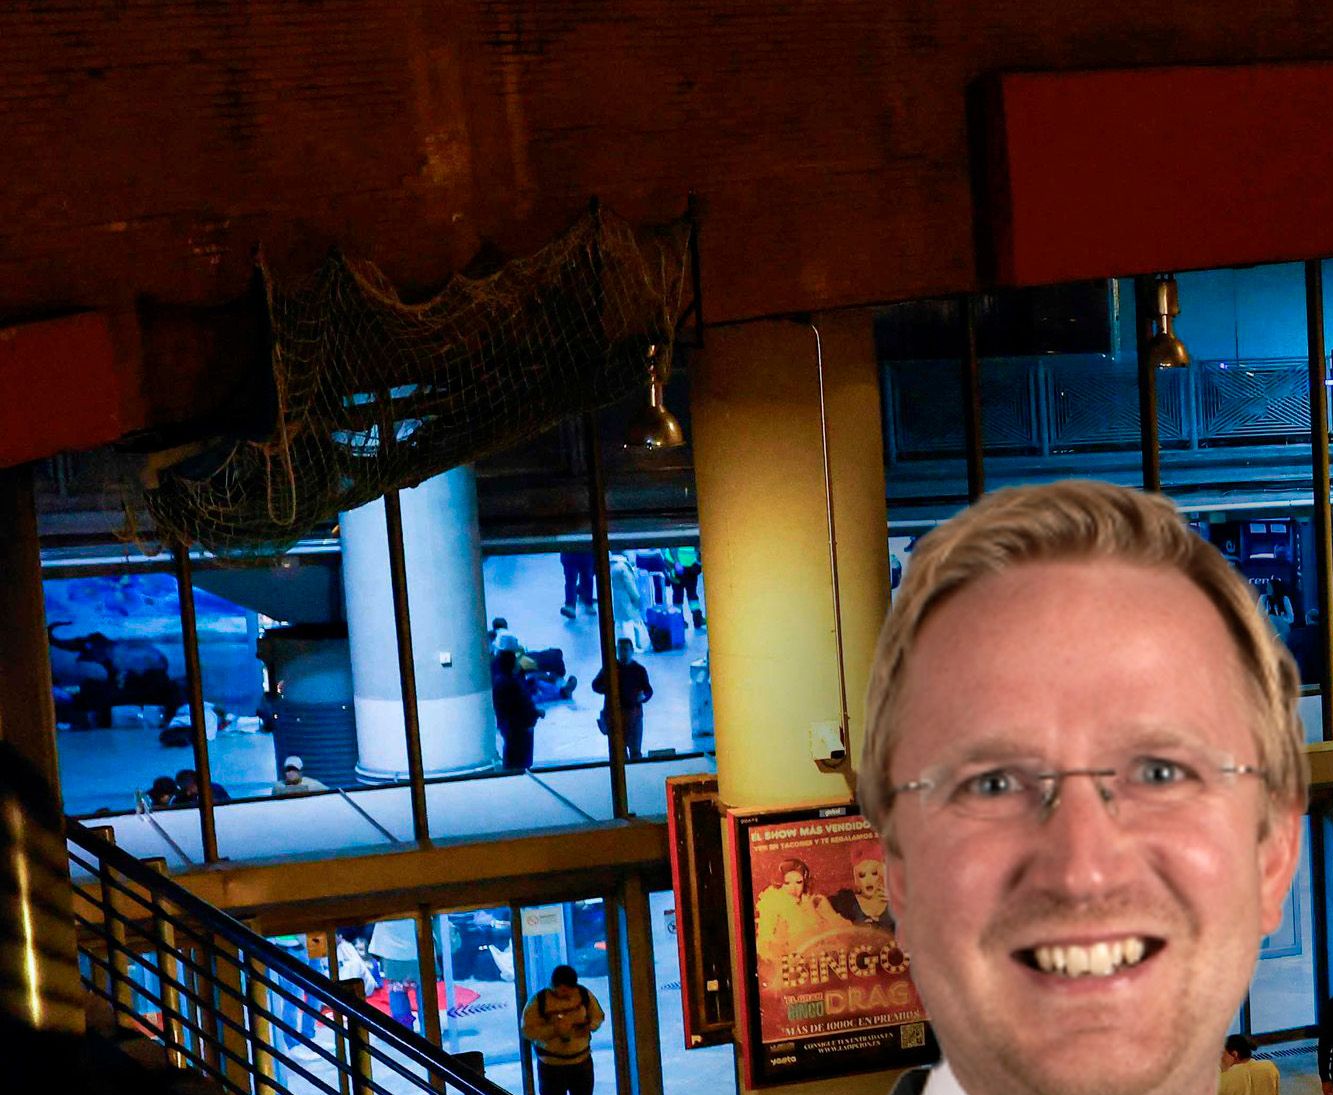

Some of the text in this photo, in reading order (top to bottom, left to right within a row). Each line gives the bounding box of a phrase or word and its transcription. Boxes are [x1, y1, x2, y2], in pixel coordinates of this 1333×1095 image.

[751, 820, 871, 842] EL SHOW MÁS VENDIDO
[782, 941, 910, 987] BINGO
[825, 981, 910, 1015] DRAG
[810, 1022, 825, 1033] DE
[858, 1017, 872, 1027] EN
